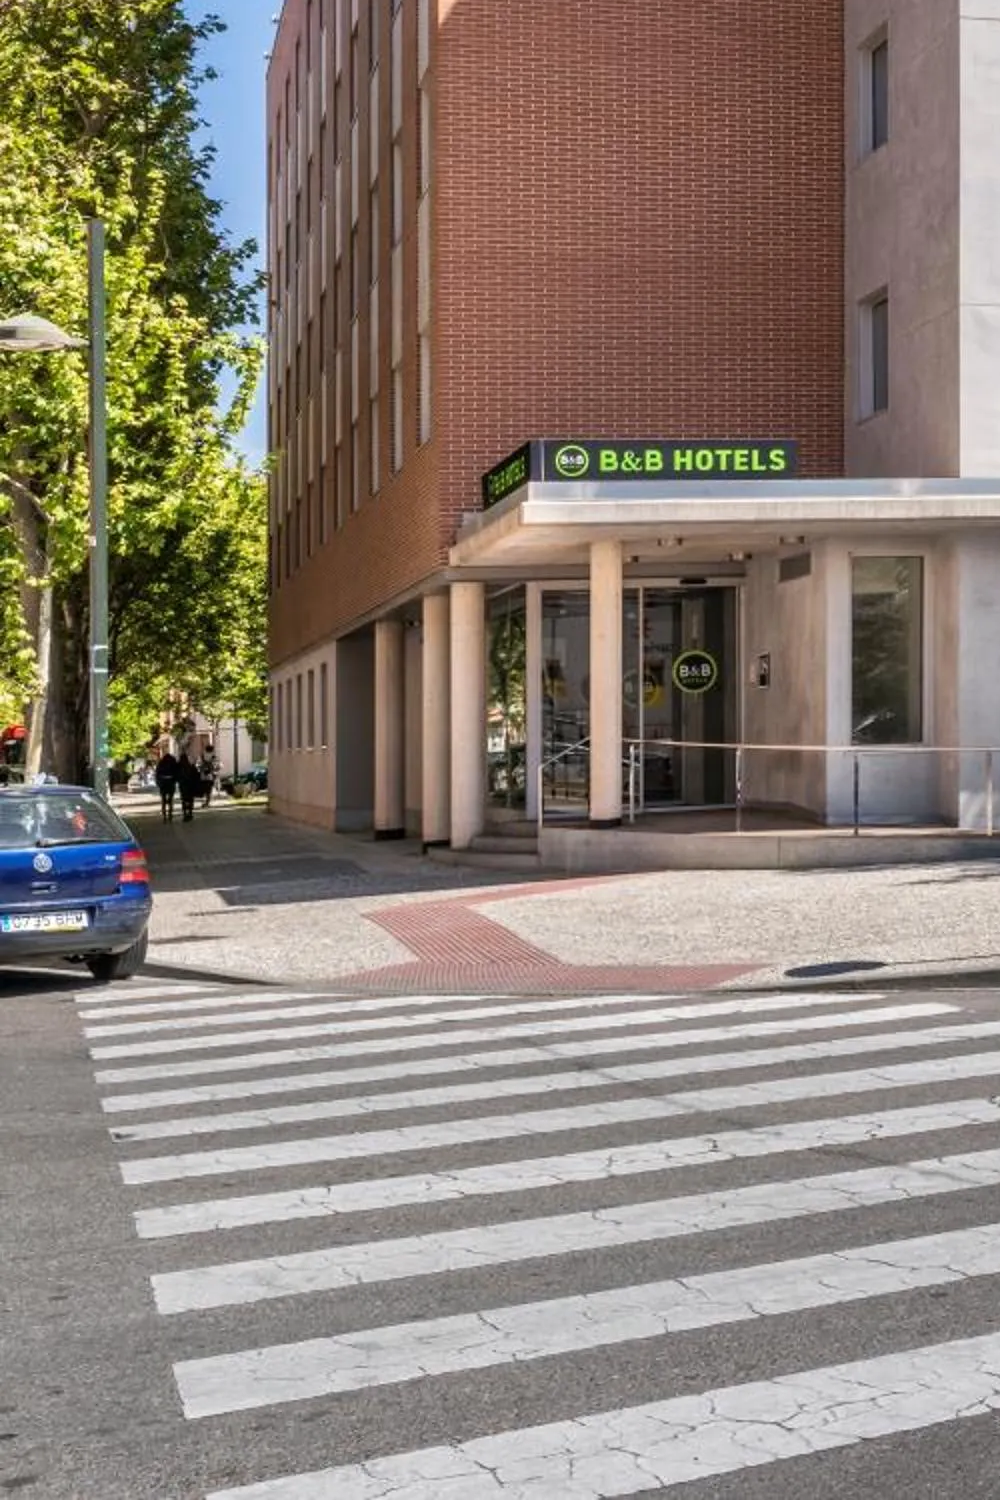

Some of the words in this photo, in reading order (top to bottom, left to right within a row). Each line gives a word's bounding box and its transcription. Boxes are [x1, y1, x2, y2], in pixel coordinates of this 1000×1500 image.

[599, 449, 664, 472] B&B
[673, 449, 786, 472] HOTELS
[679, 663, 711, 677] B&B
